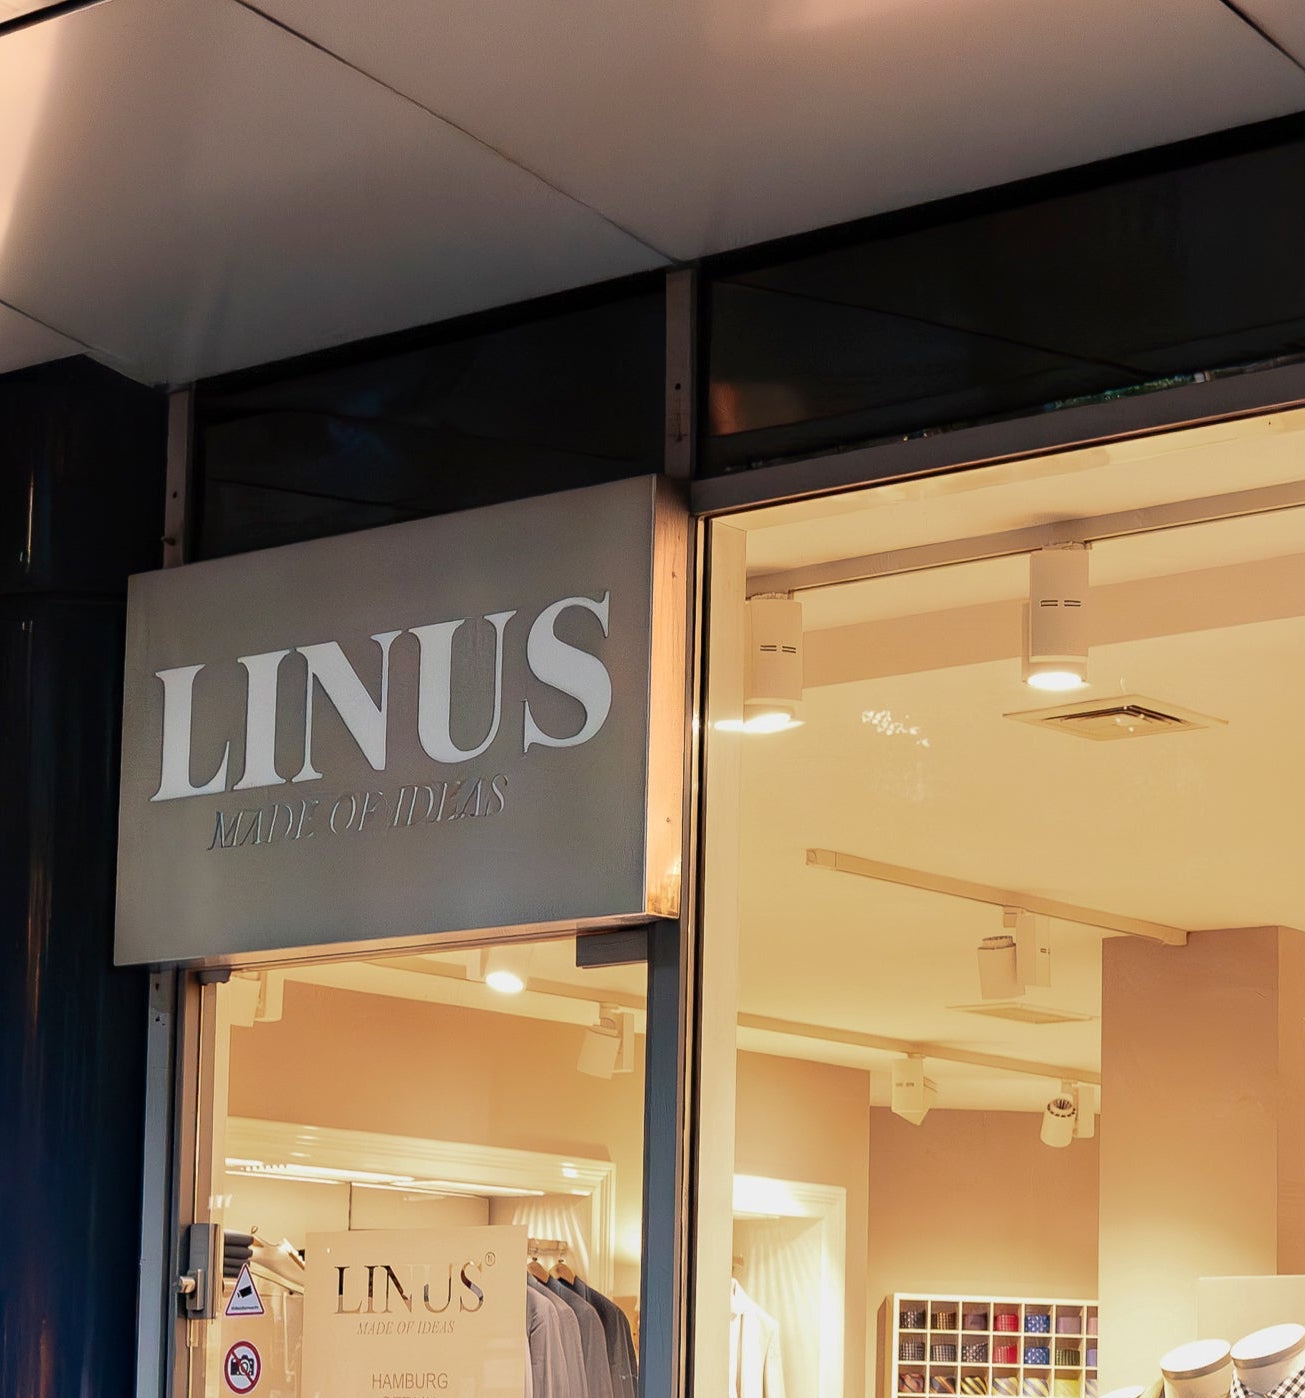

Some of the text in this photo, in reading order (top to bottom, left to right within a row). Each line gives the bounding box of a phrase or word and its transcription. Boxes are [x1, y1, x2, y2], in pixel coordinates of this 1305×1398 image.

[150, 591, 613, 802] LINUS
[207, 774, 510, 850] MADE OF IDEAS
[333, 1261, 485, 1315] LINUS
[356, 1320, 455, 1335] MADE OF IDEAS
[372, 1372, 448, 1390] HAMBURG
